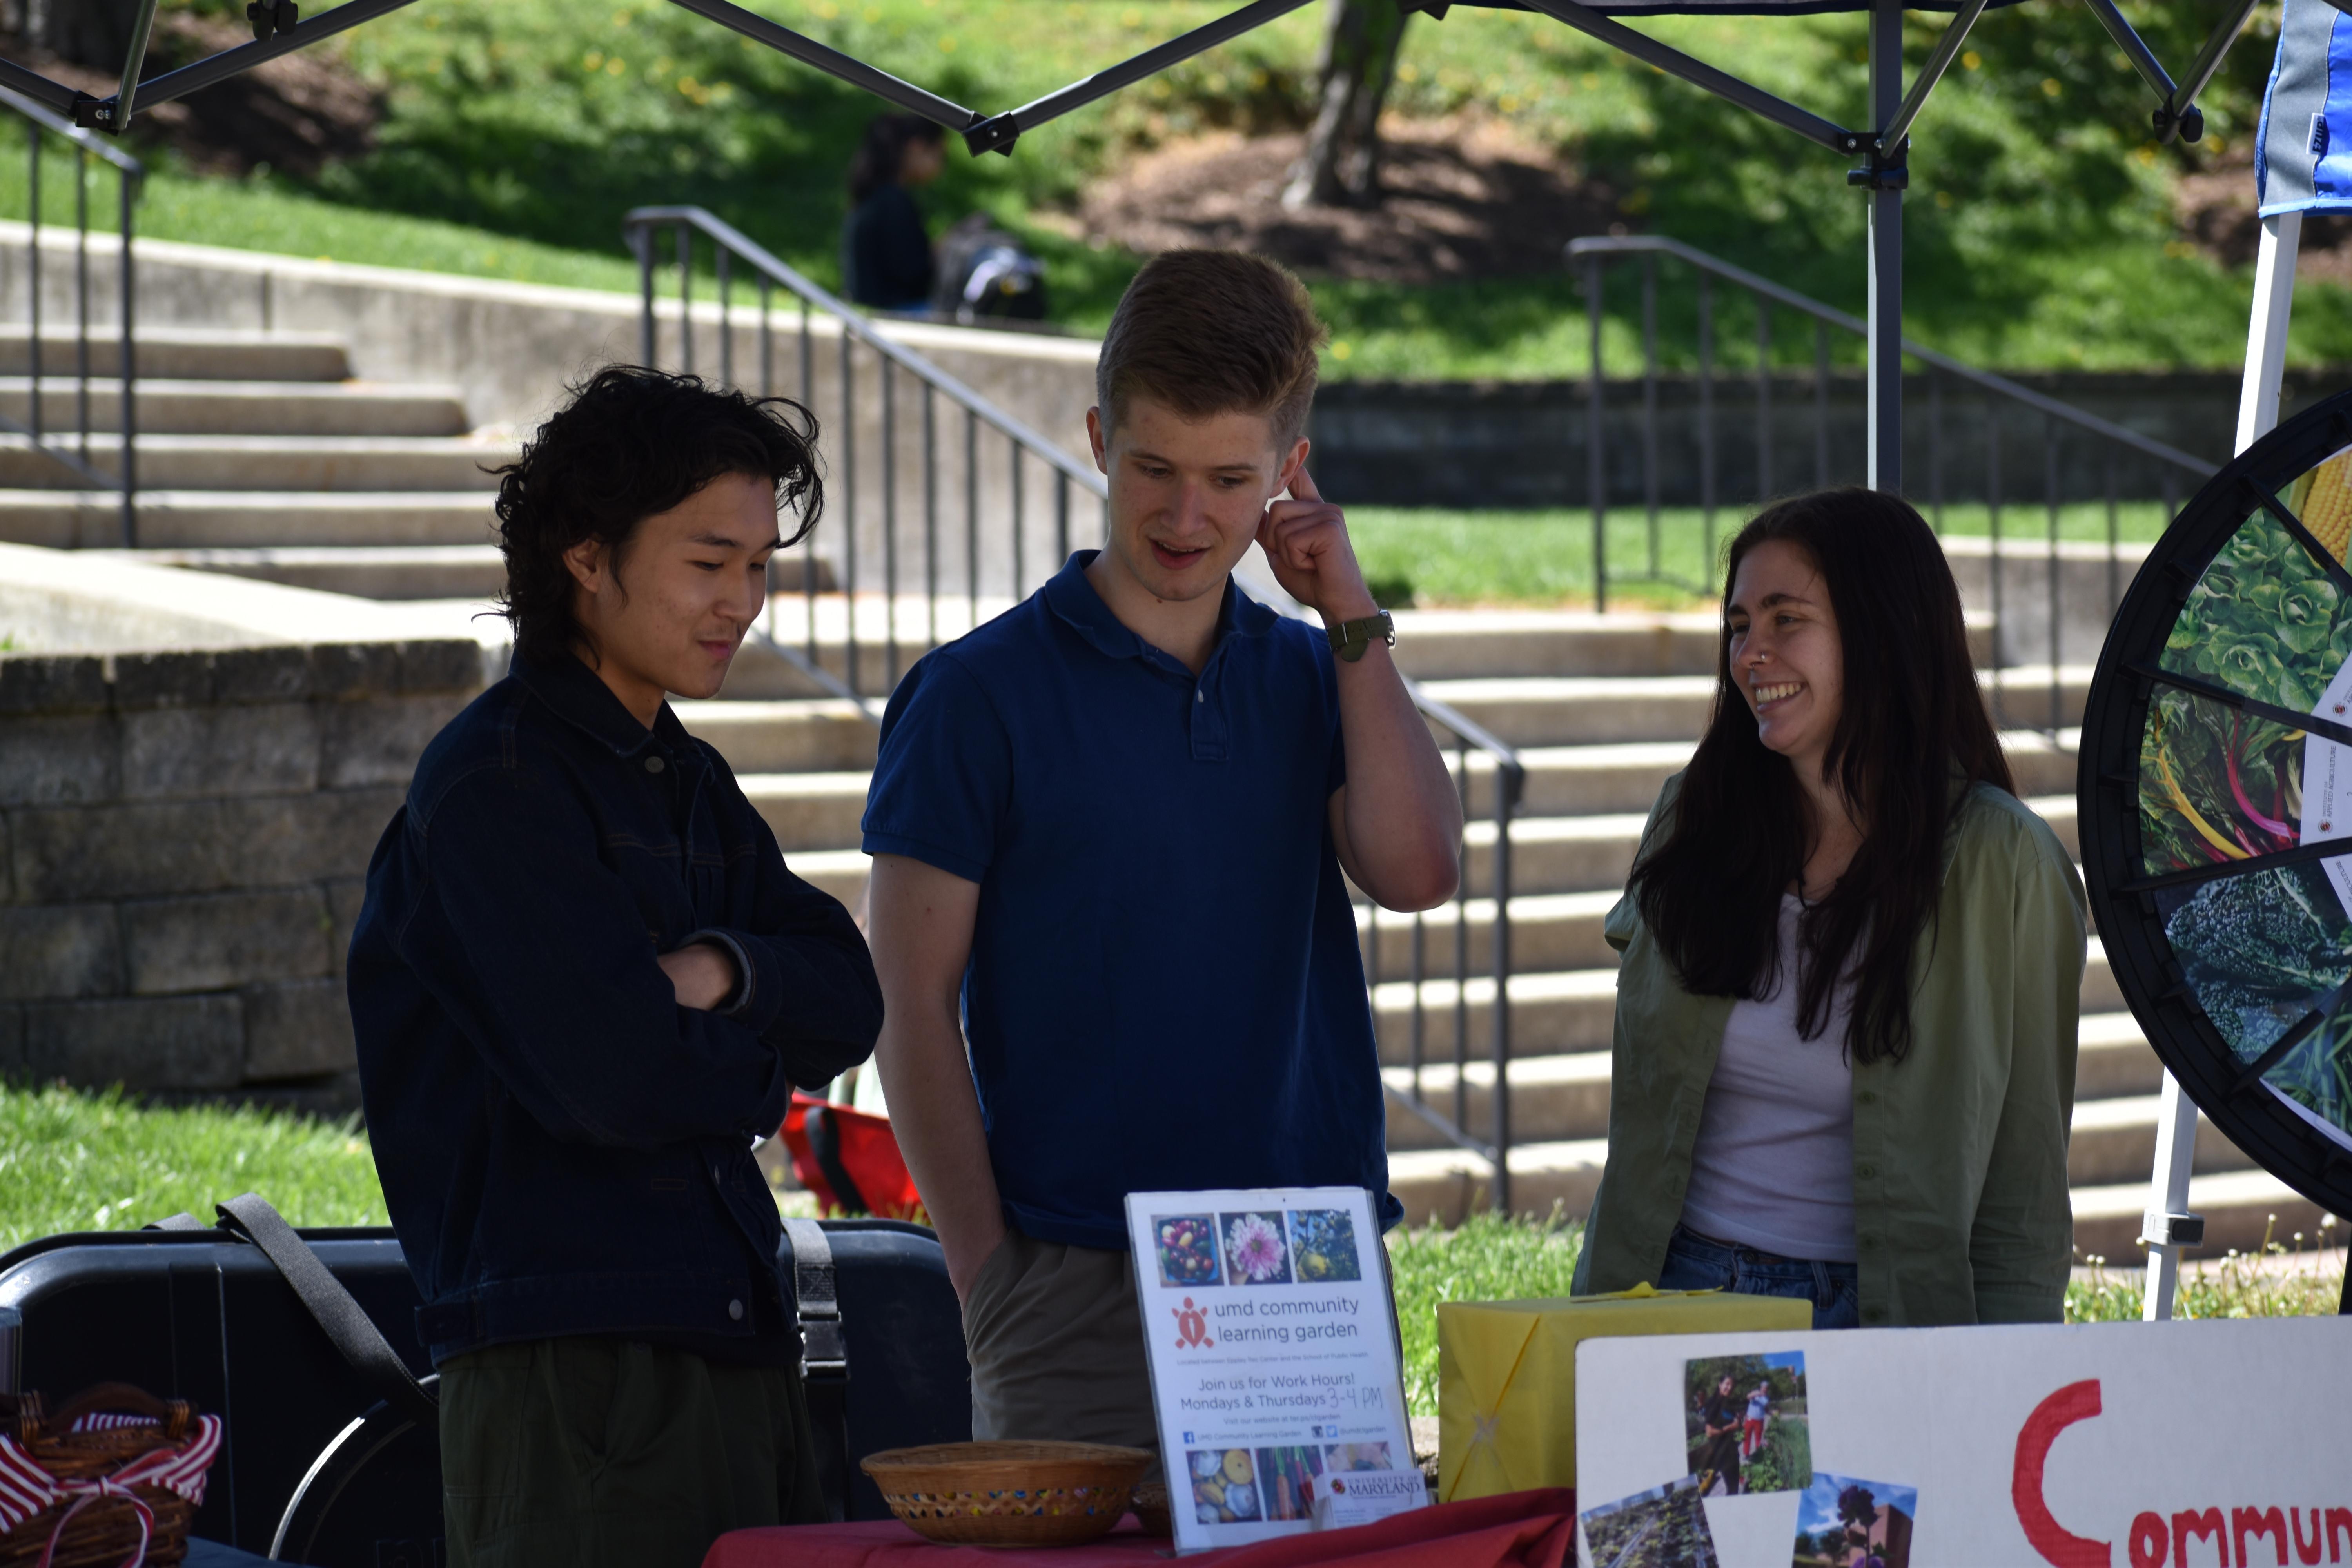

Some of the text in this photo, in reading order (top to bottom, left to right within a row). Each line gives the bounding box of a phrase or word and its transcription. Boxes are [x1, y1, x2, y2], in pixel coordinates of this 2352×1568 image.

[2328, 746, 2336, 791] AGRICULTURE
[1215, 1296, 1359, 1317] umd community
[1218, 1321, 1357, 1343] learning garden
[1198, 1372, 1355, 1392] Join us for Work Hours!
[1180, 1393, 1326, 1412] Mondays & Thursdays
[1327, 1387, 1383, 1409] 3-4 PM
[1214, 1432, 1249, 1441] Community
[1250, 1431, 1278, 1440] Learning
[1349, 1483, 1420, 1496] MARYLAND
